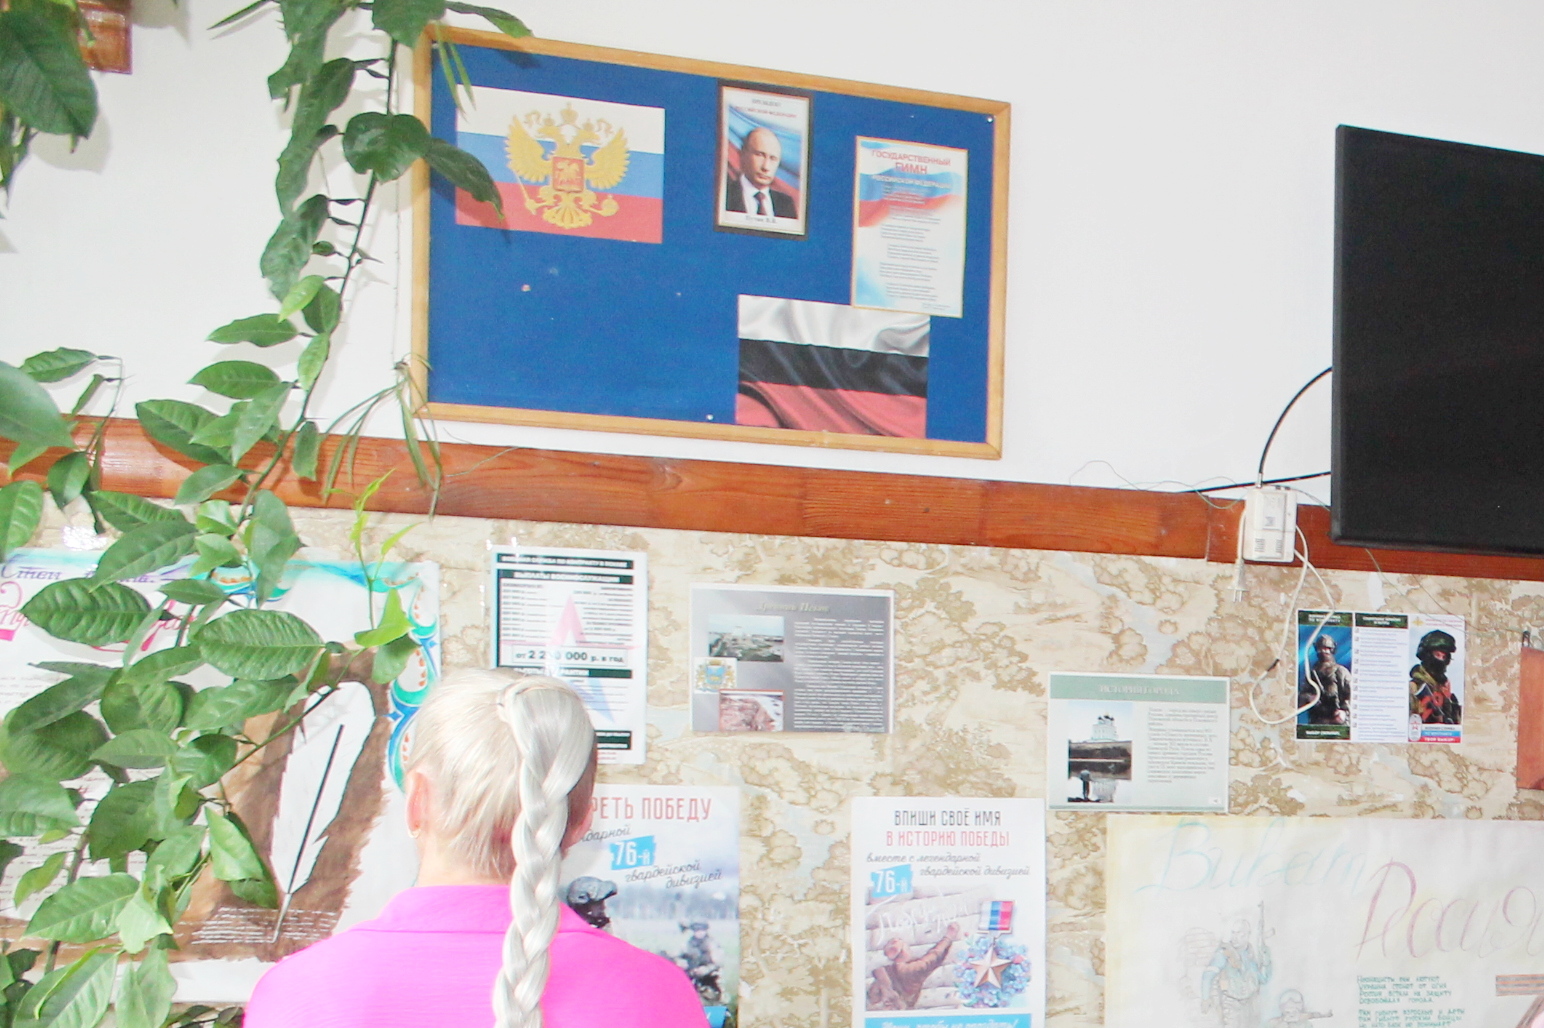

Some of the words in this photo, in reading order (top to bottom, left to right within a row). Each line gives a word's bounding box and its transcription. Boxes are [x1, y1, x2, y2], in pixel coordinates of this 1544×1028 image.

[870, 149, 952, 167] ГОСУДАРСТВЕННЫЙ
[895, 162, 928, 175] ГИМН
[528, 650, 536, 660] 2
[565, 651, 588, 661] 000
[591, 797, 634, 819] РЕТЬ
[641, 797, 712, 822] ПОБЕДУ
[894, 810, 937, 827] ВПИШИ
[941, 807, 970, 827] СВОЁ
[974, 810, 1002, 827] ИМЯ
[582, 824, 632, 844] дарной
[886, 830, 893, 847] В
[898, 830, 956, 847] ИСТОРИЮ
[960, 830, 1010, 848] ПОБЕДЫ
[614, 841, 651, 866] 76-й
[866, 852, 908, 863] вместе
[916, 852, 981, 864] легендарной
[624, 860, 701, 884] гвардейской
[665, 868, 723, 890] дивизией
[1356, 858, 1544, 961] Россия
